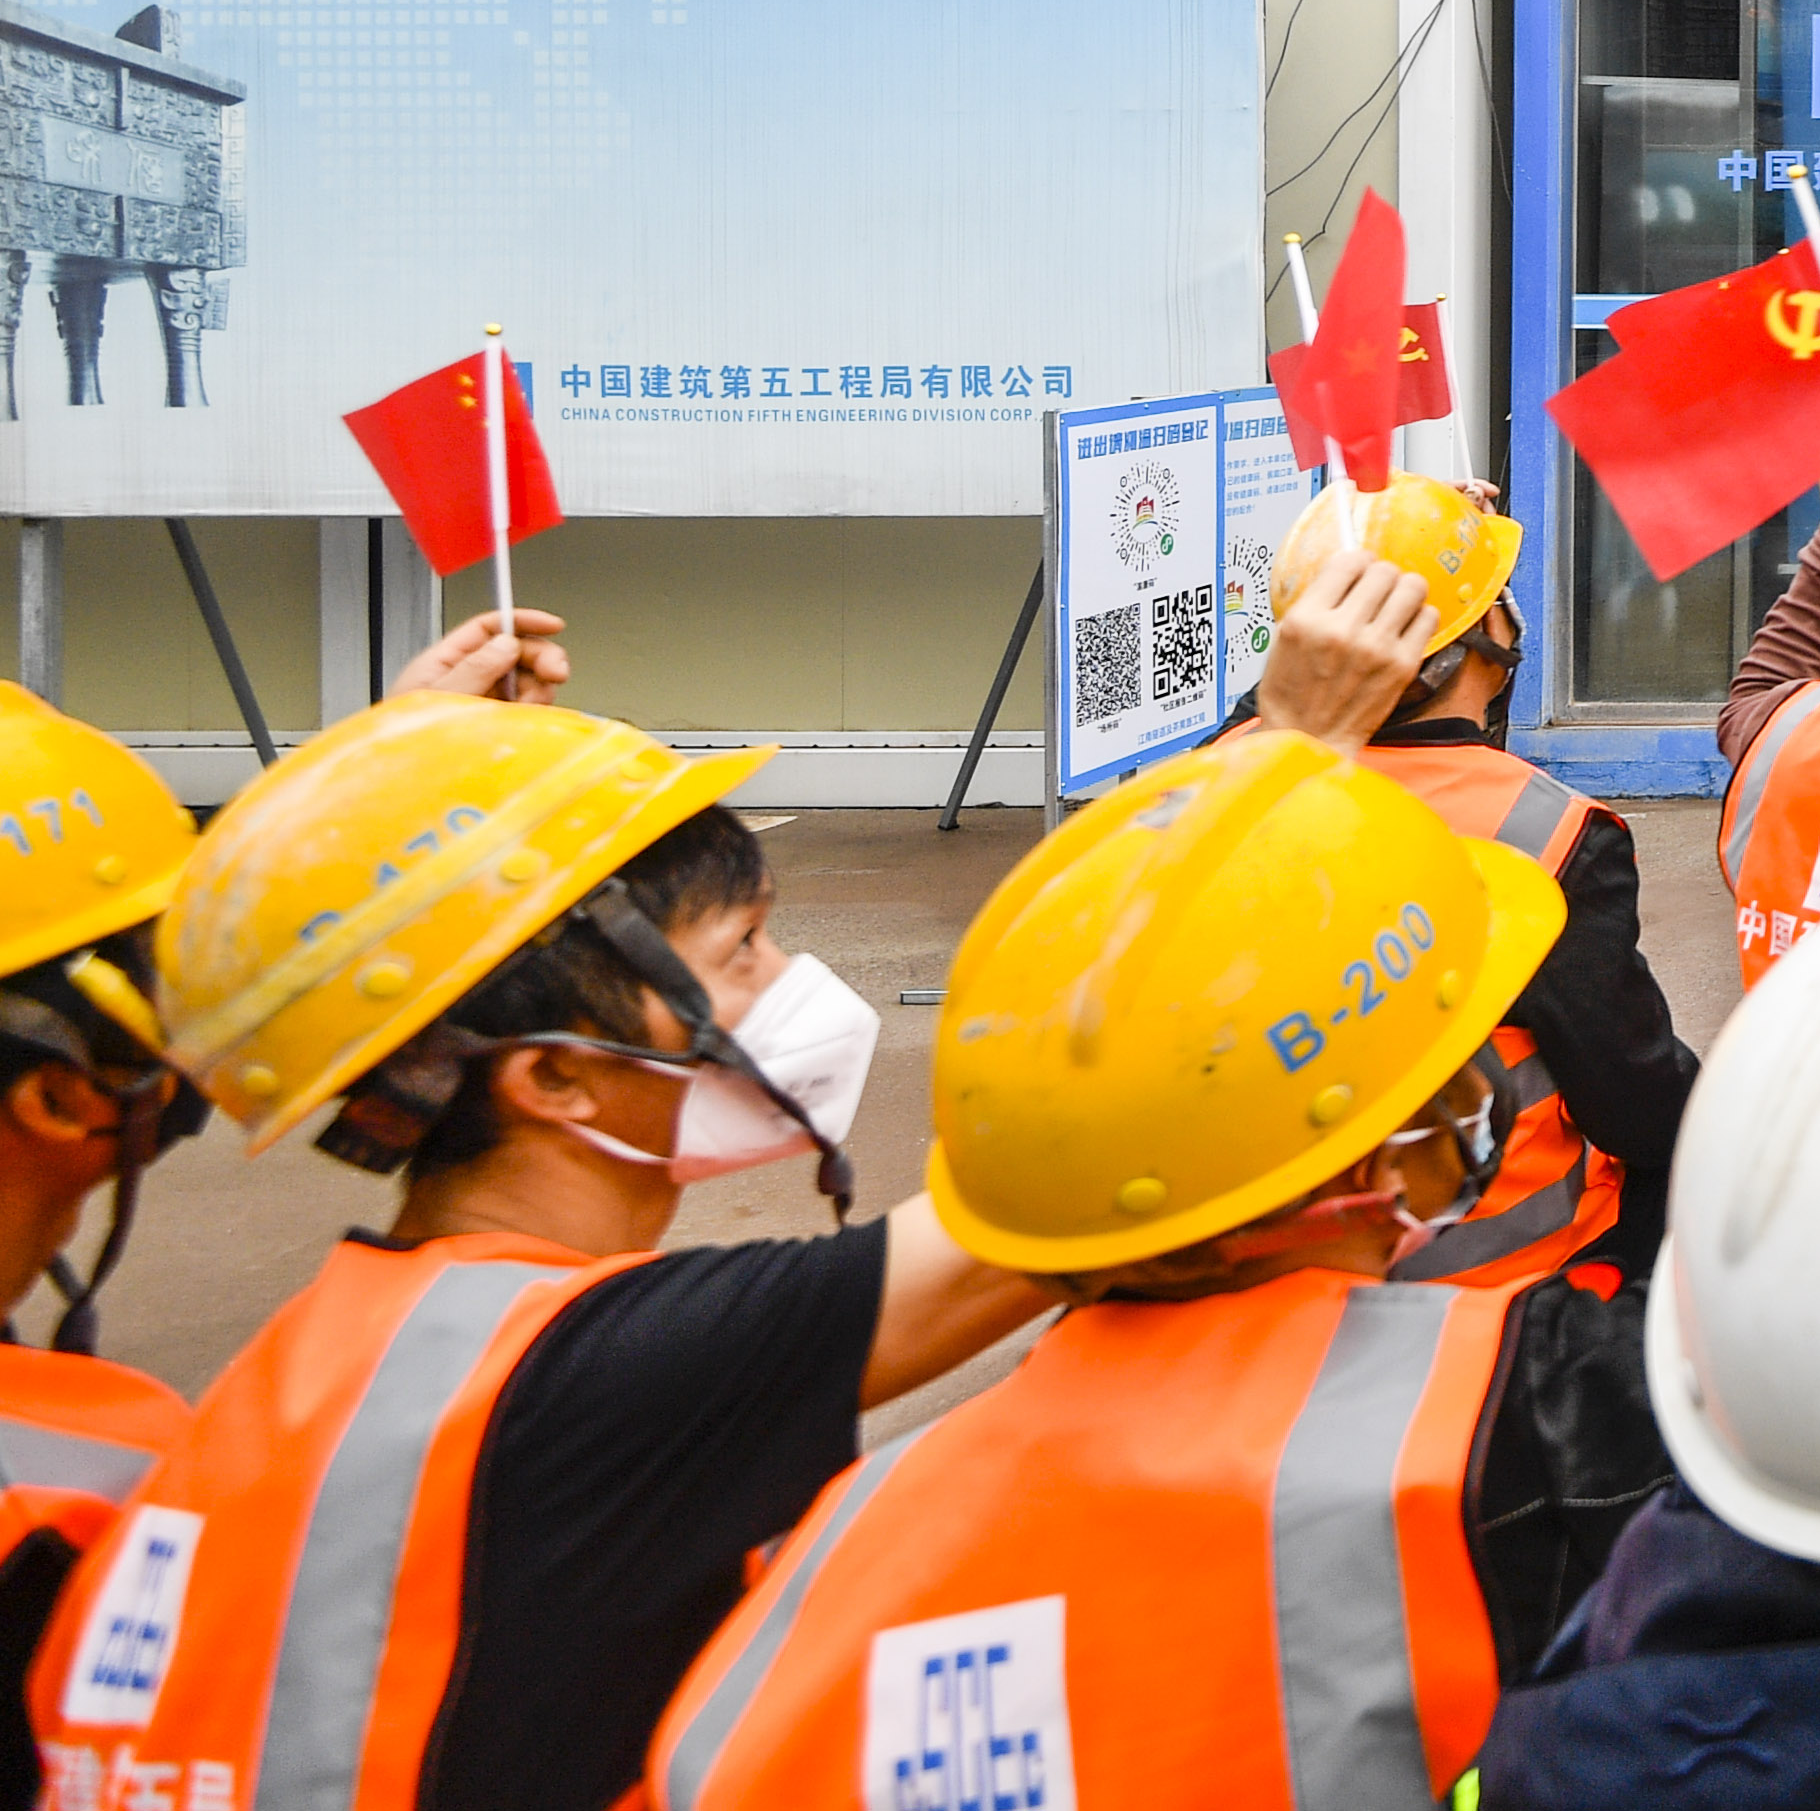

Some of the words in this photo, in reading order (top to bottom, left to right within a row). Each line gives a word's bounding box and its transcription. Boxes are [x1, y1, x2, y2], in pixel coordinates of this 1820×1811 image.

[561, 363, 1073, 400] 中国建筑第五工程局有限公司
[561, 407, 611, 421] CHINA
[615, 408, 743, 422] CONSTRUCTION
[748, 408, 792, 422] FIFTH
[796, 408, 907, 422] ENGINEERING
[912, 408, 982, 422] DIVISION
[1265, 901, 1436, 1073] B-200
